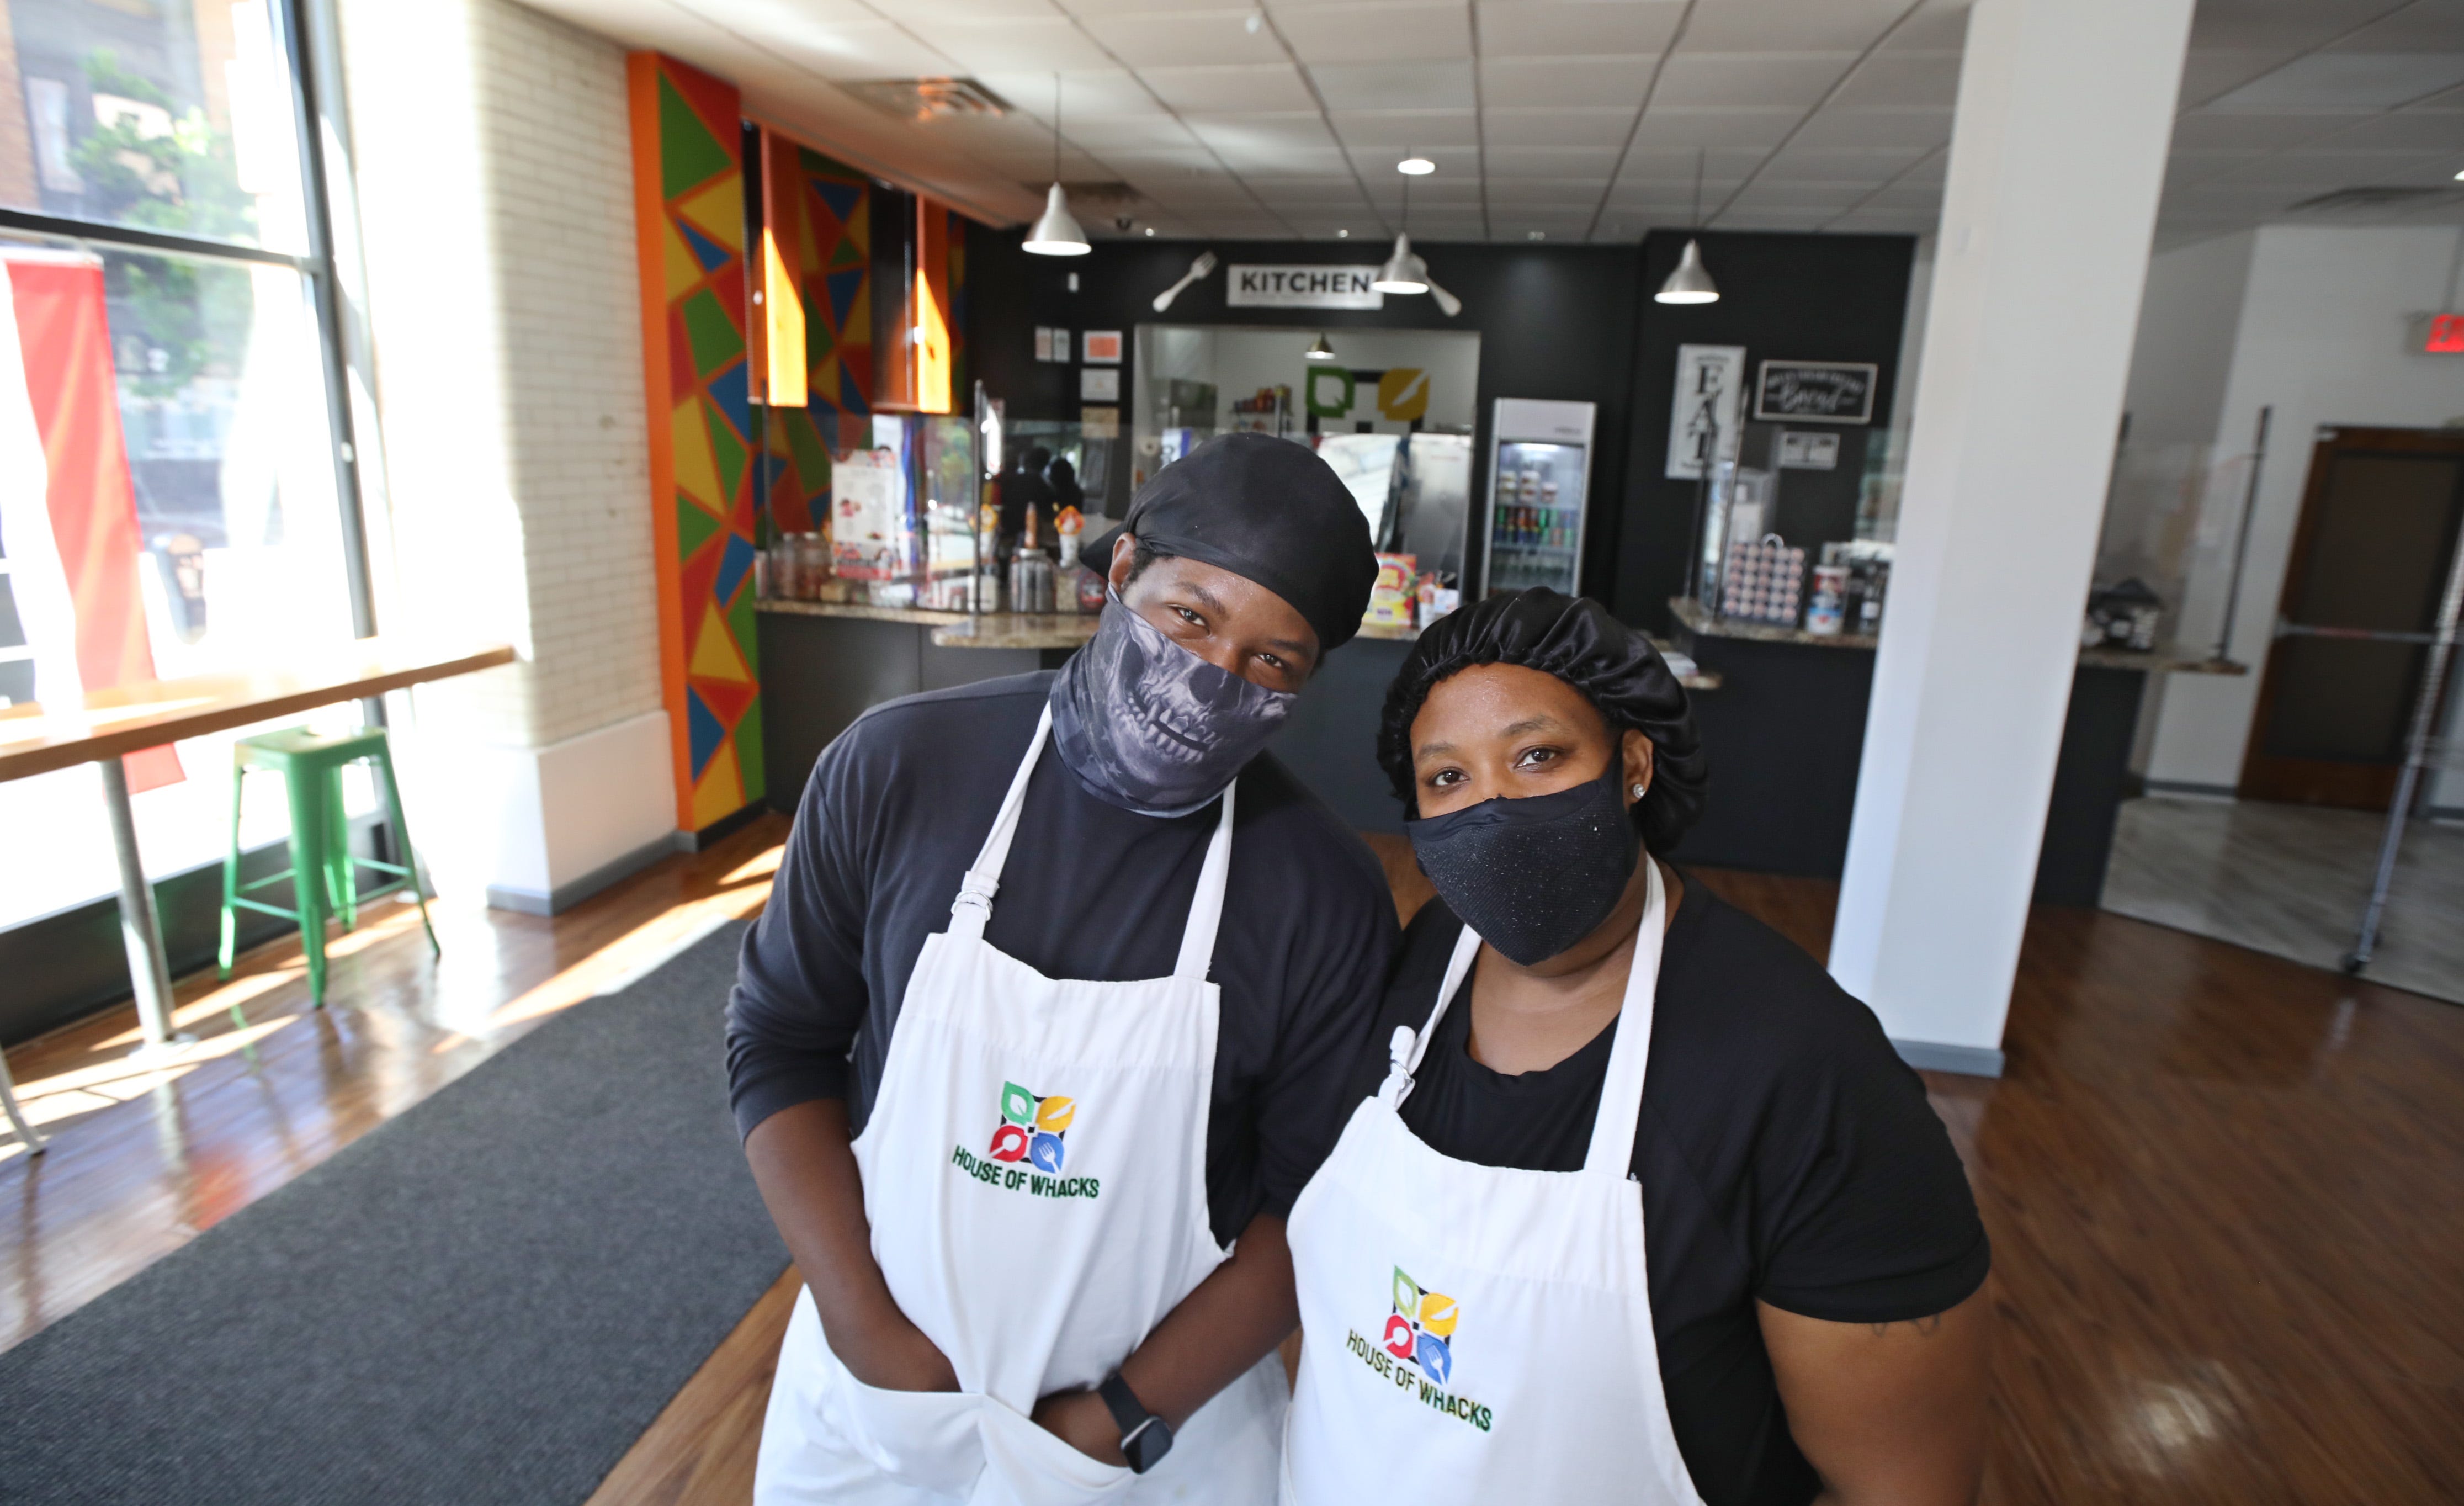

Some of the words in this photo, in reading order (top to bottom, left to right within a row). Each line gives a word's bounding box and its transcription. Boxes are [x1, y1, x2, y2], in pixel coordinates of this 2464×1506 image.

[1241, 272, 1370, 293] KITCHEN
[1688, 365, 1723, 460] EAT
[952, 1144, 1002, 1185] HOUSE
[1005, 1169, 1027, 1191] OF
[1030, 1174, 1100, 1198] WHACKS
[1346, 1329, 1393, 1379] HOUSE
[1395, 1366, 1416, 1391] OF
[1419, 1379, 1492, 1432] WHACKS
